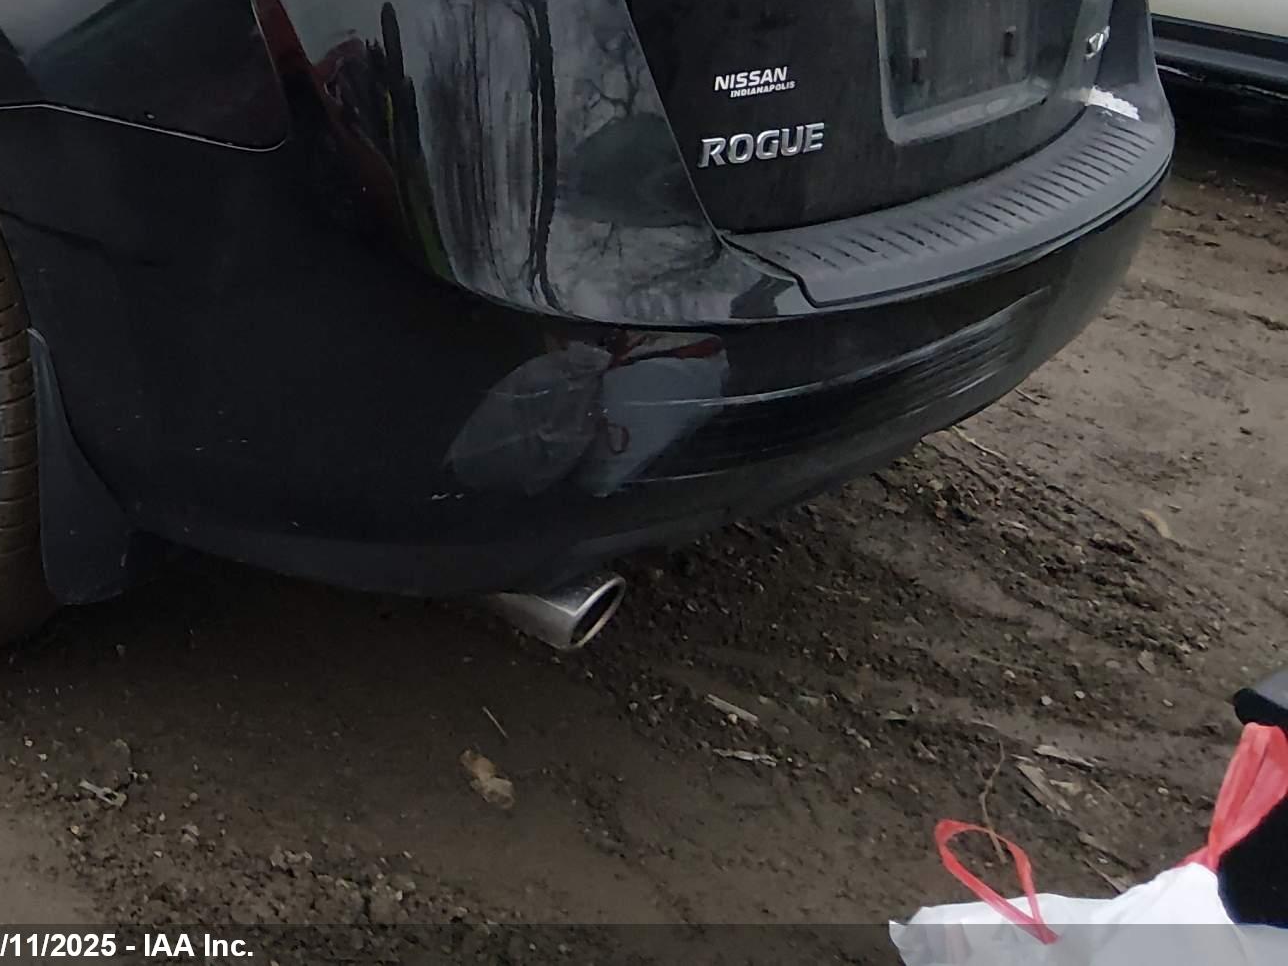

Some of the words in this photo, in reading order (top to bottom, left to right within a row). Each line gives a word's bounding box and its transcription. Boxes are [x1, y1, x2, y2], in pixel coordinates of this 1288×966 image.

[714, 66, 787, 91] NISSAN
[730, 81, 796, 98] INDIANAPOLIS
[697, 122, 825, 168] ROGUE
